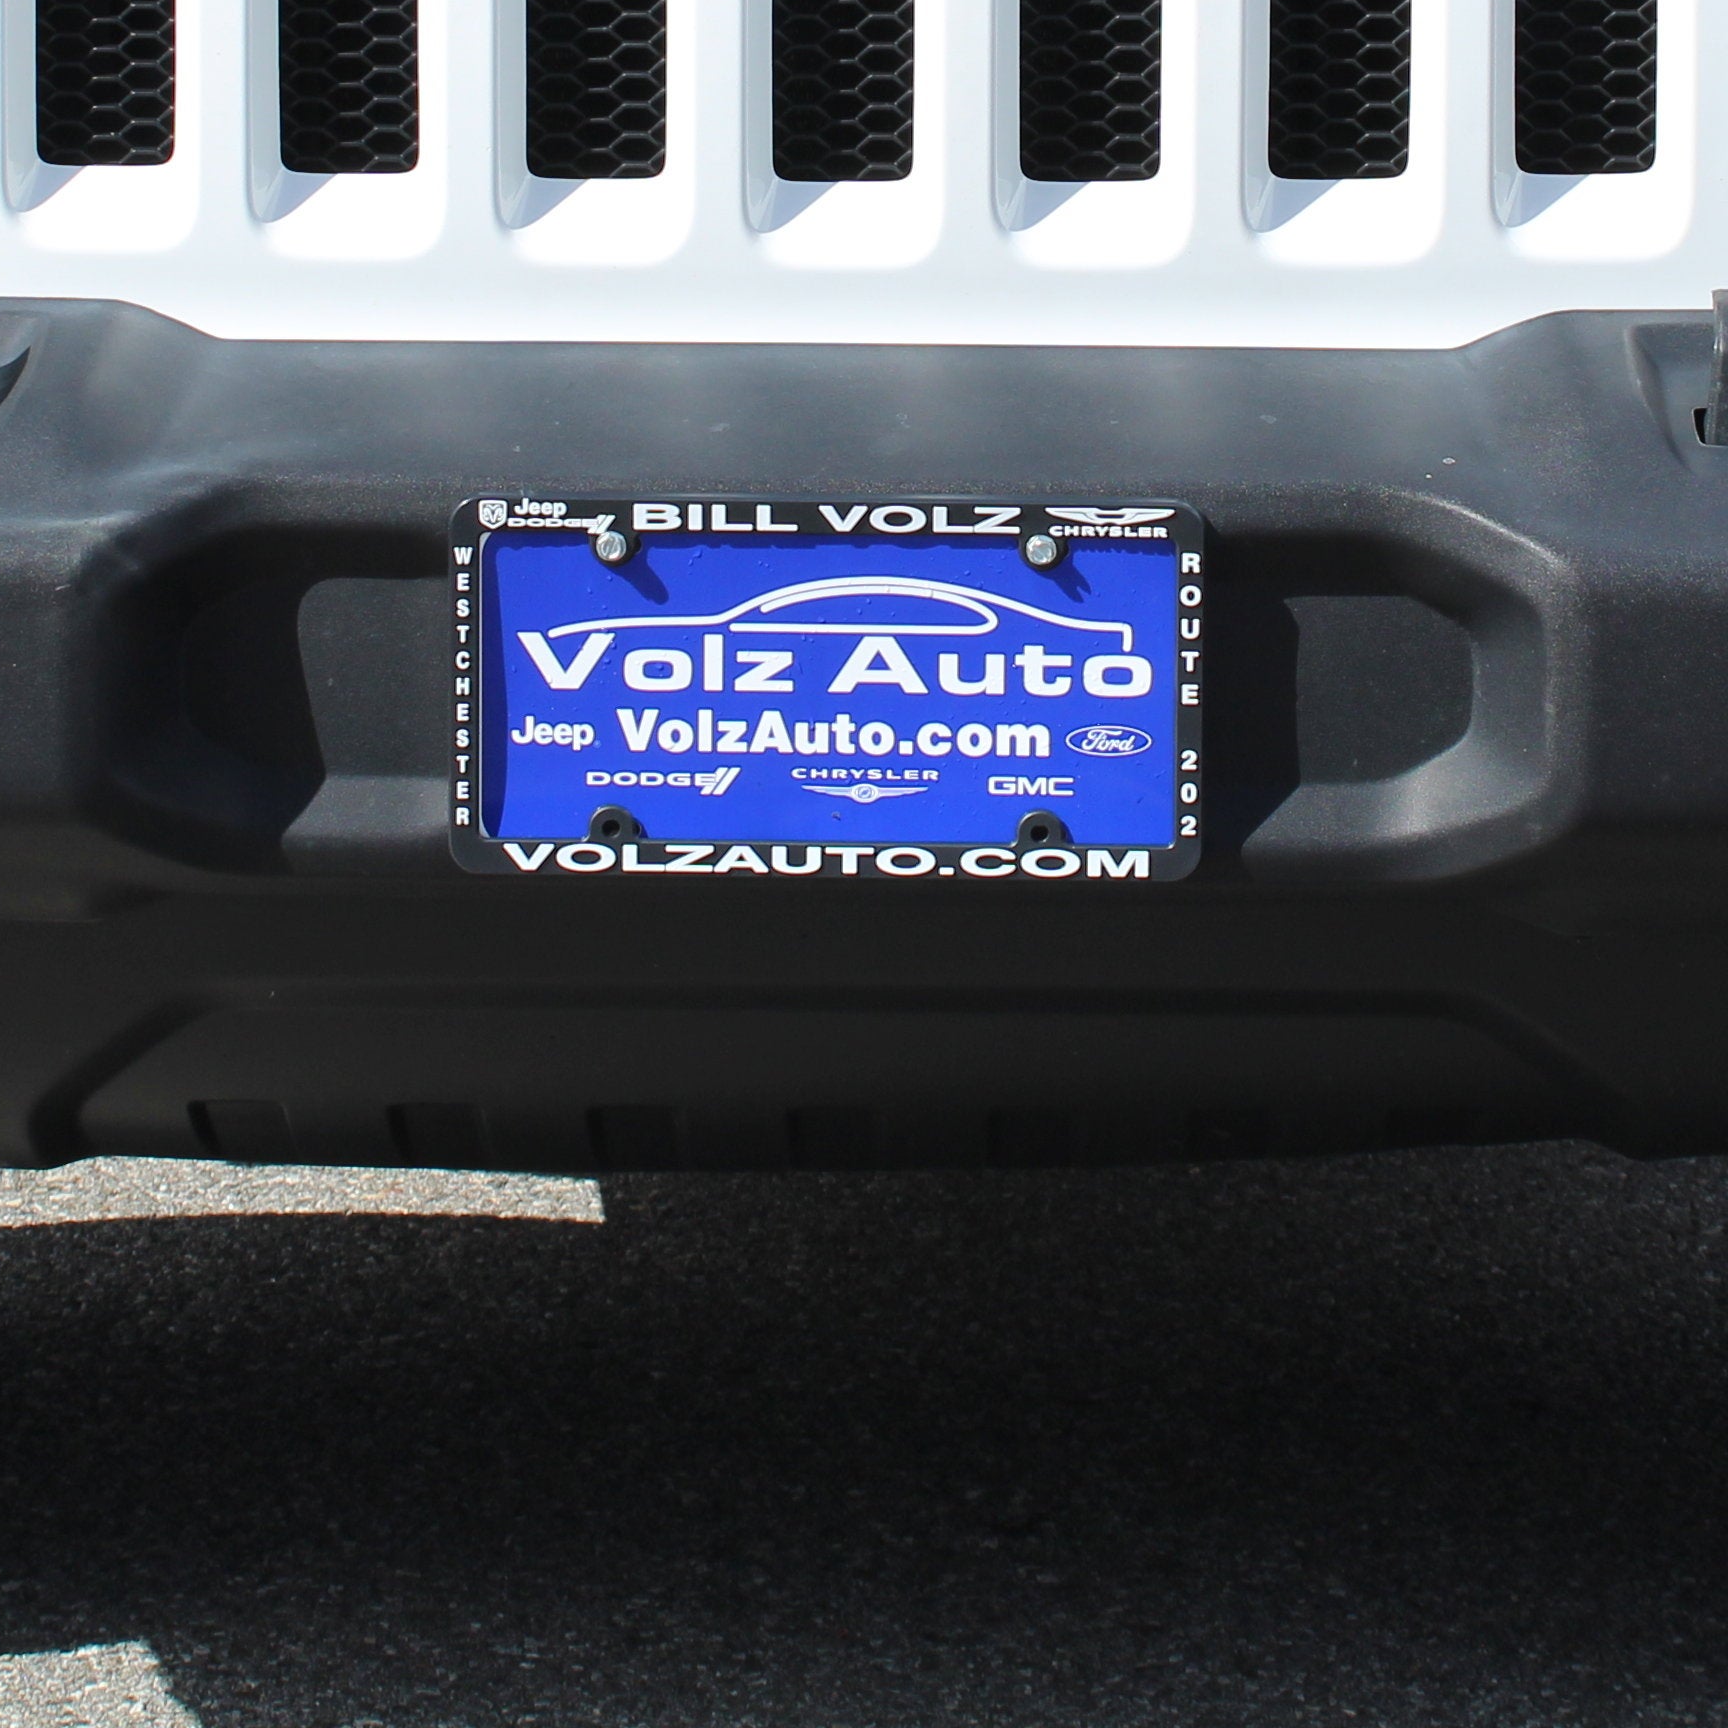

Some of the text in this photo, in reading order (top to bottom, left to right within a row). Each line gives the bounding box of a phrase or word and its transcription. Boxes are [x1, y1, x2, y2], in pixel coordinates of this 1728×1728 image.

[514, 498, 568, 516] Jeep
[632, 503, 1022, 535] BILL VOLZ
[507, 516, 601, 529] DODGE
[1048, 525, 1169, 539] CHRYSLER
[516, 631, 1153, 698] Volz Auto
[453, 546, 473, 826] WESTCHESTER
[1179, 552, 1202, 836] ROUTE 202
[510, 714, 596, 752] Jeep
[615, 707, 1051, 758] VolzAuto.com
[1080, 727, 1136, 753] Ford
[585, 771, 718, 788] DODGE
[790, 767, 941, 782] CHRYSLER
[987, 775, 1076, 797] GMC
[503, 843, 1152, 879] VOLZAUTO.COM
